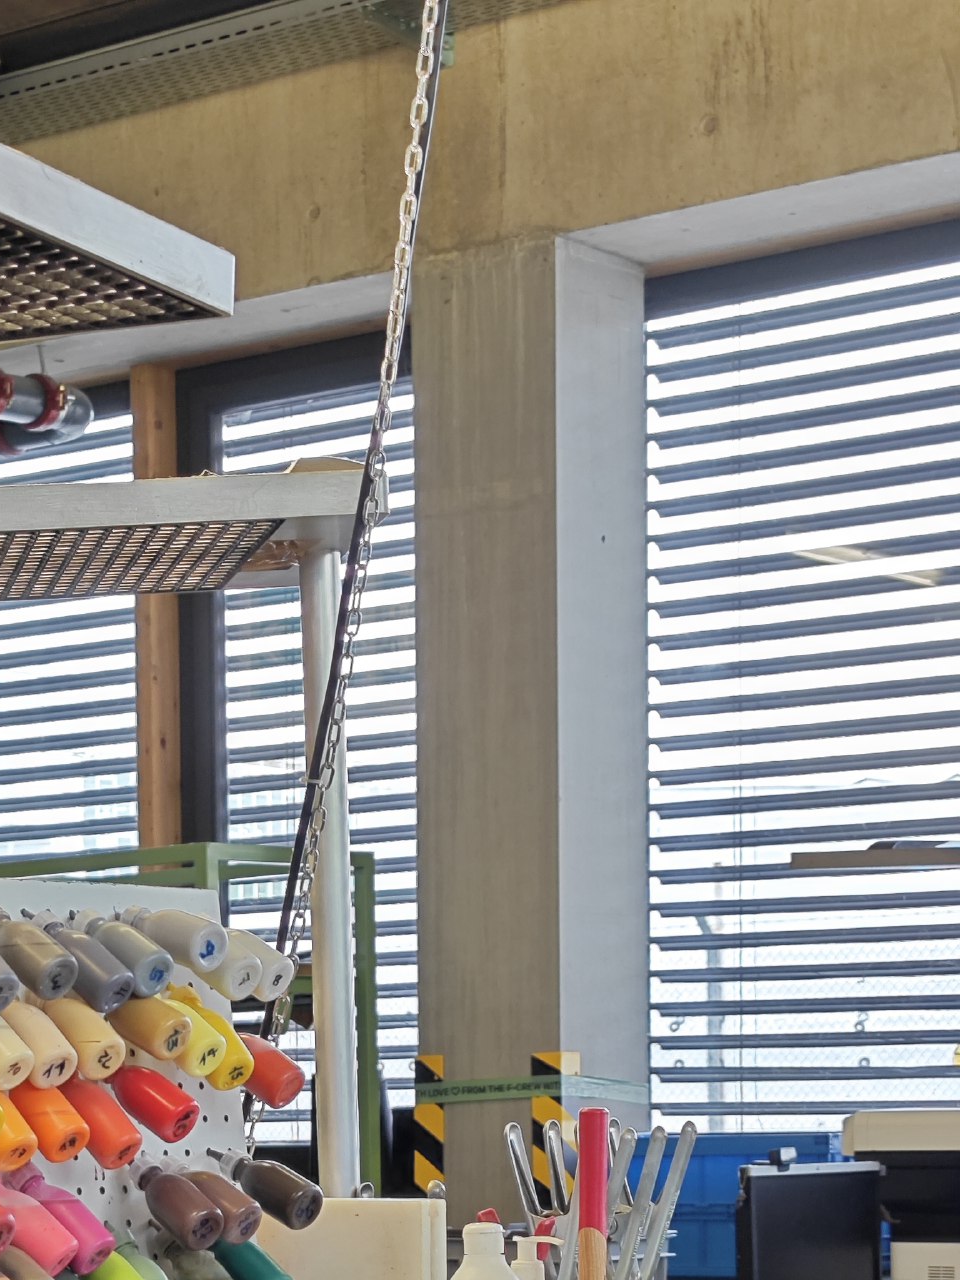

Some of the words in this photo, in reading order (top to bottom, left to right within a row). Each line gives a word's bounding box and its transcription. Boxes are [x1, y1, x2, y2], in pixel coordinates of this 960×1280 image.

[272, 974, 284, 987] 8
[428, 1087, 449, 1097] LOVE
[461, 1086, 486, 1095] FROM
[488, 1084, 505, 1093] THE
[506, 1082, 541, 1092] F-CREW
